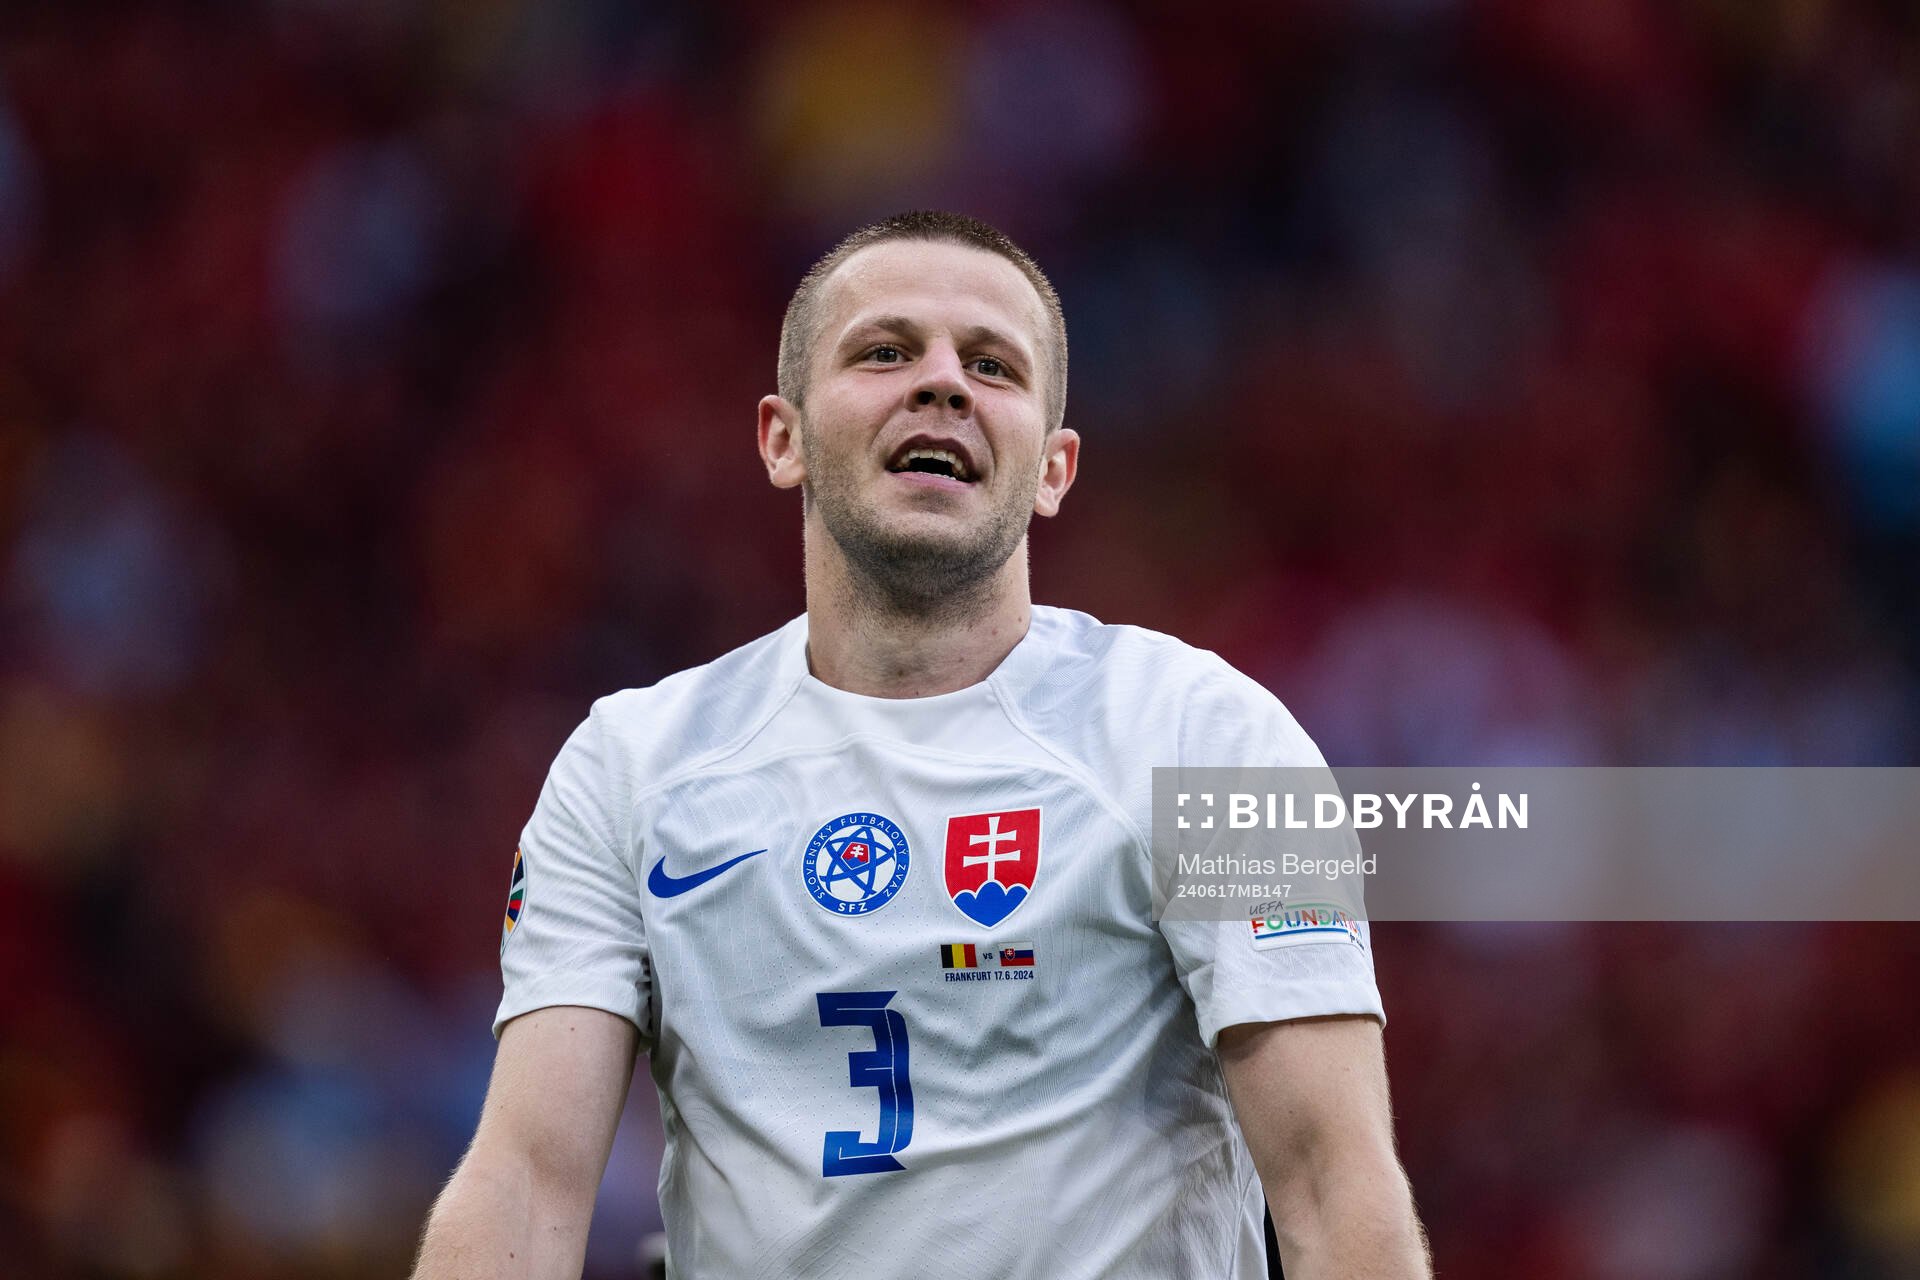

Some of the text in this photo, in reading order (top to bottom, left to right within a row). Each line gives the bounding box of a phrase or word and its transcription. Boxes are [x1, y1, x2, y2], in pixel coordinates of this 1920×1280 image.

[838, 902, 868, 913] SFZ
[1249, 900, 1284, 915] UEFA
[945, 970, 1034, 982] FRANKFURT 17.6.2024
[816, 991, 914, 1178] 3
